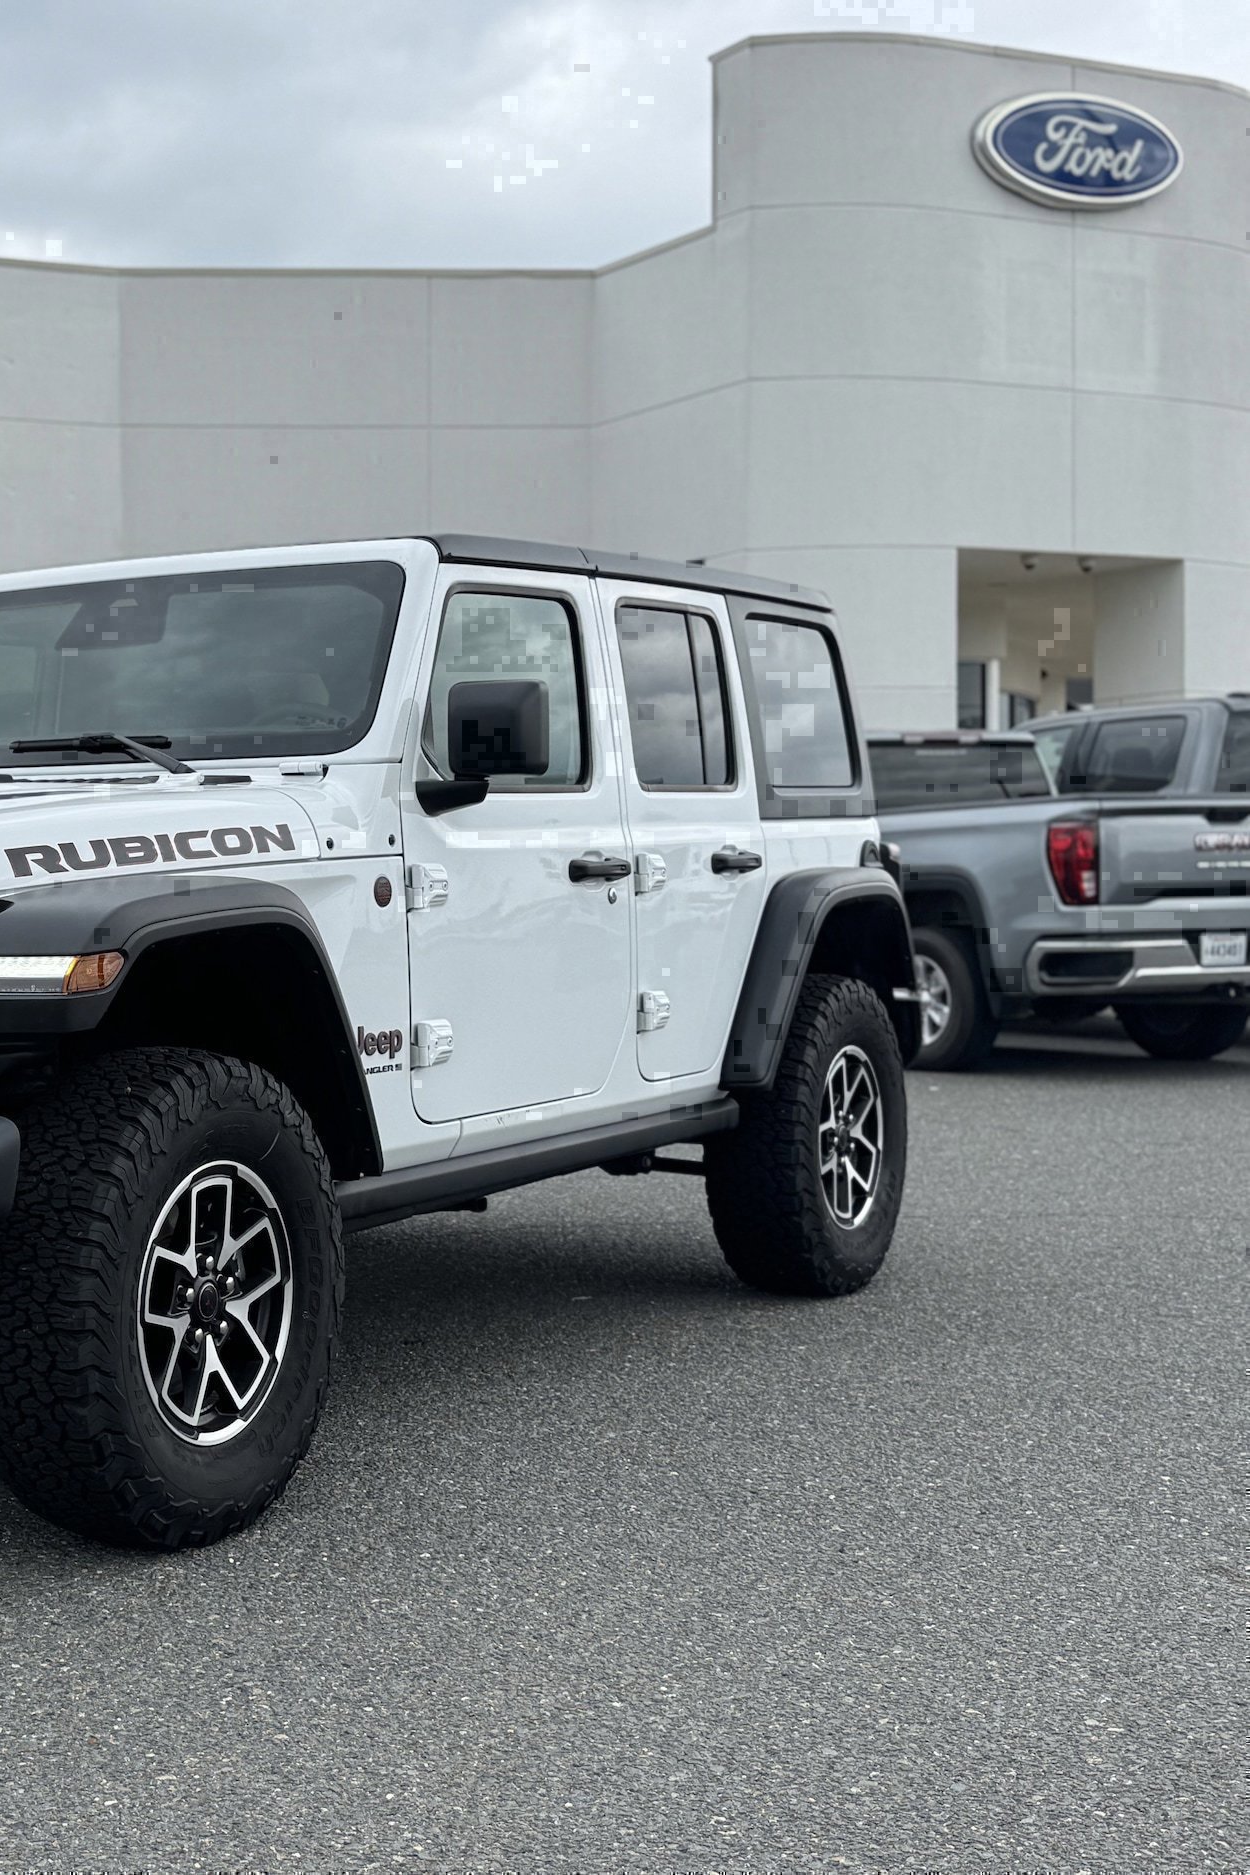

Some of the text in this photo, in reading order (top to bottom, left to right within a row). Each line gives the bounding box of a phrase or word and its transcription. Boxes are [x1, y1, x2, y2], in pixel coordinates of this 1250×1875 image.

[1034, 114, 1144, 182] Ford
[4, 824, 295, 877] RUBICON
[357, 1025, 403, 1060] Jeep
